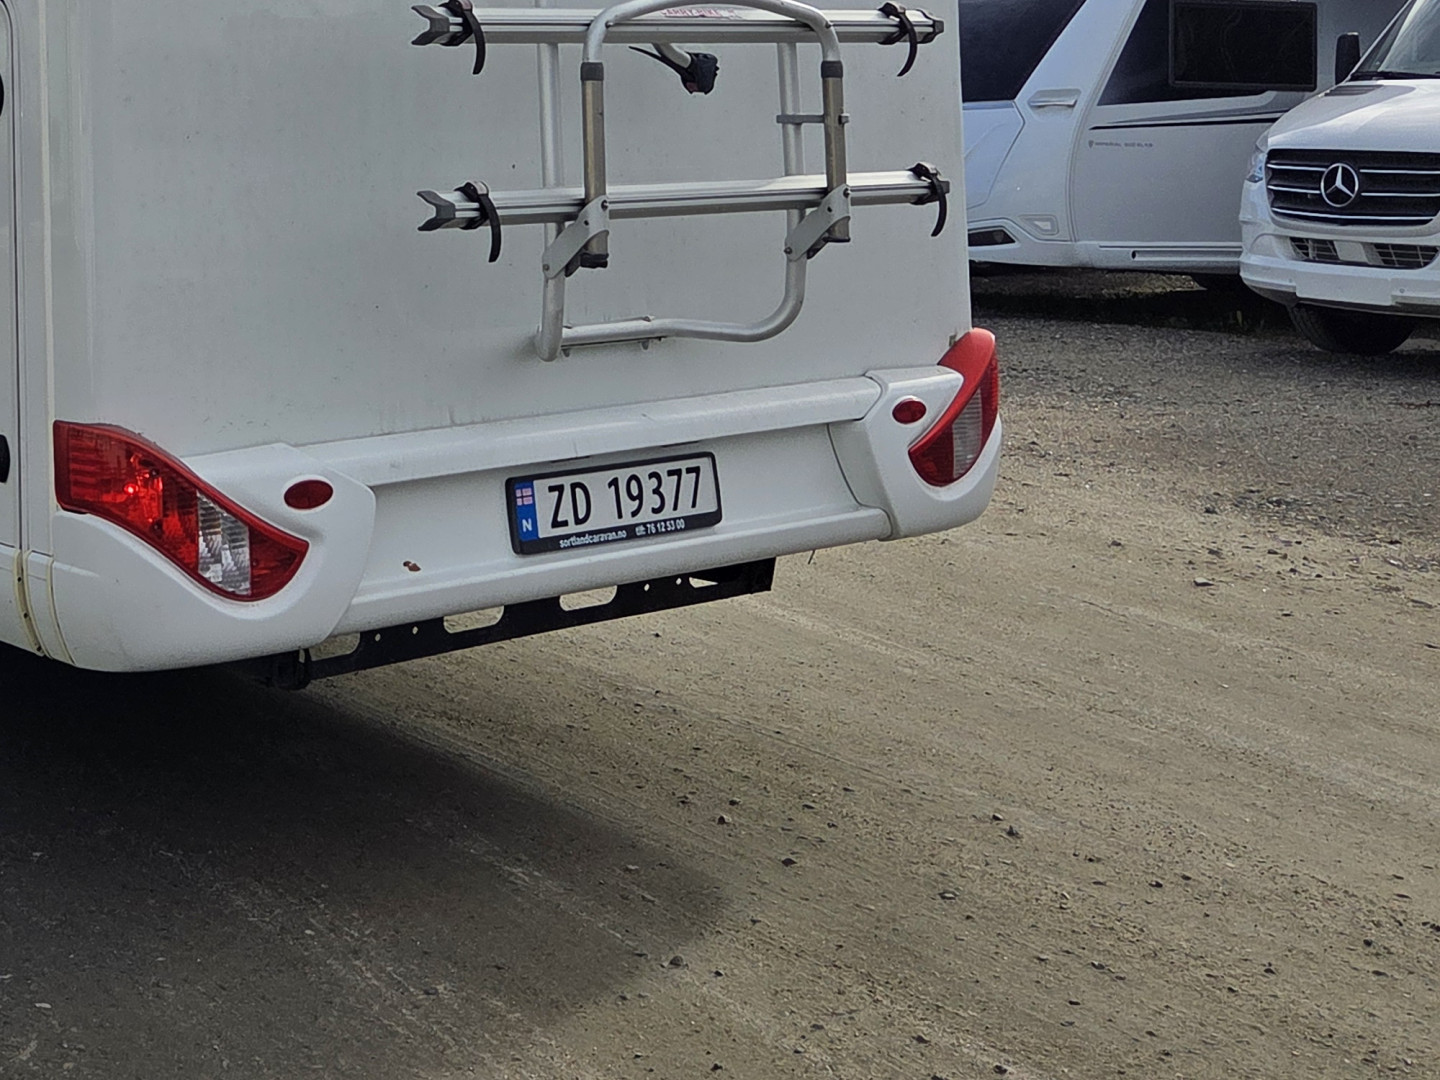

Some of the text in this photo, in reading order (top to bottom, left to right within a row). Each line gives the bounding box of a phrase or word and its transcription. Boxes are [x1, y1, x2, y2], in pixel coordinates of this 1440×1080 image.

[547, 465, 701, 529] ZD 19377
[521, 518, 533, 533] N
[559, 529, 627, 549] sortlandcaravan.no
[656, 522, 666, 533] 12
[676, 518, 686, 530] 00
